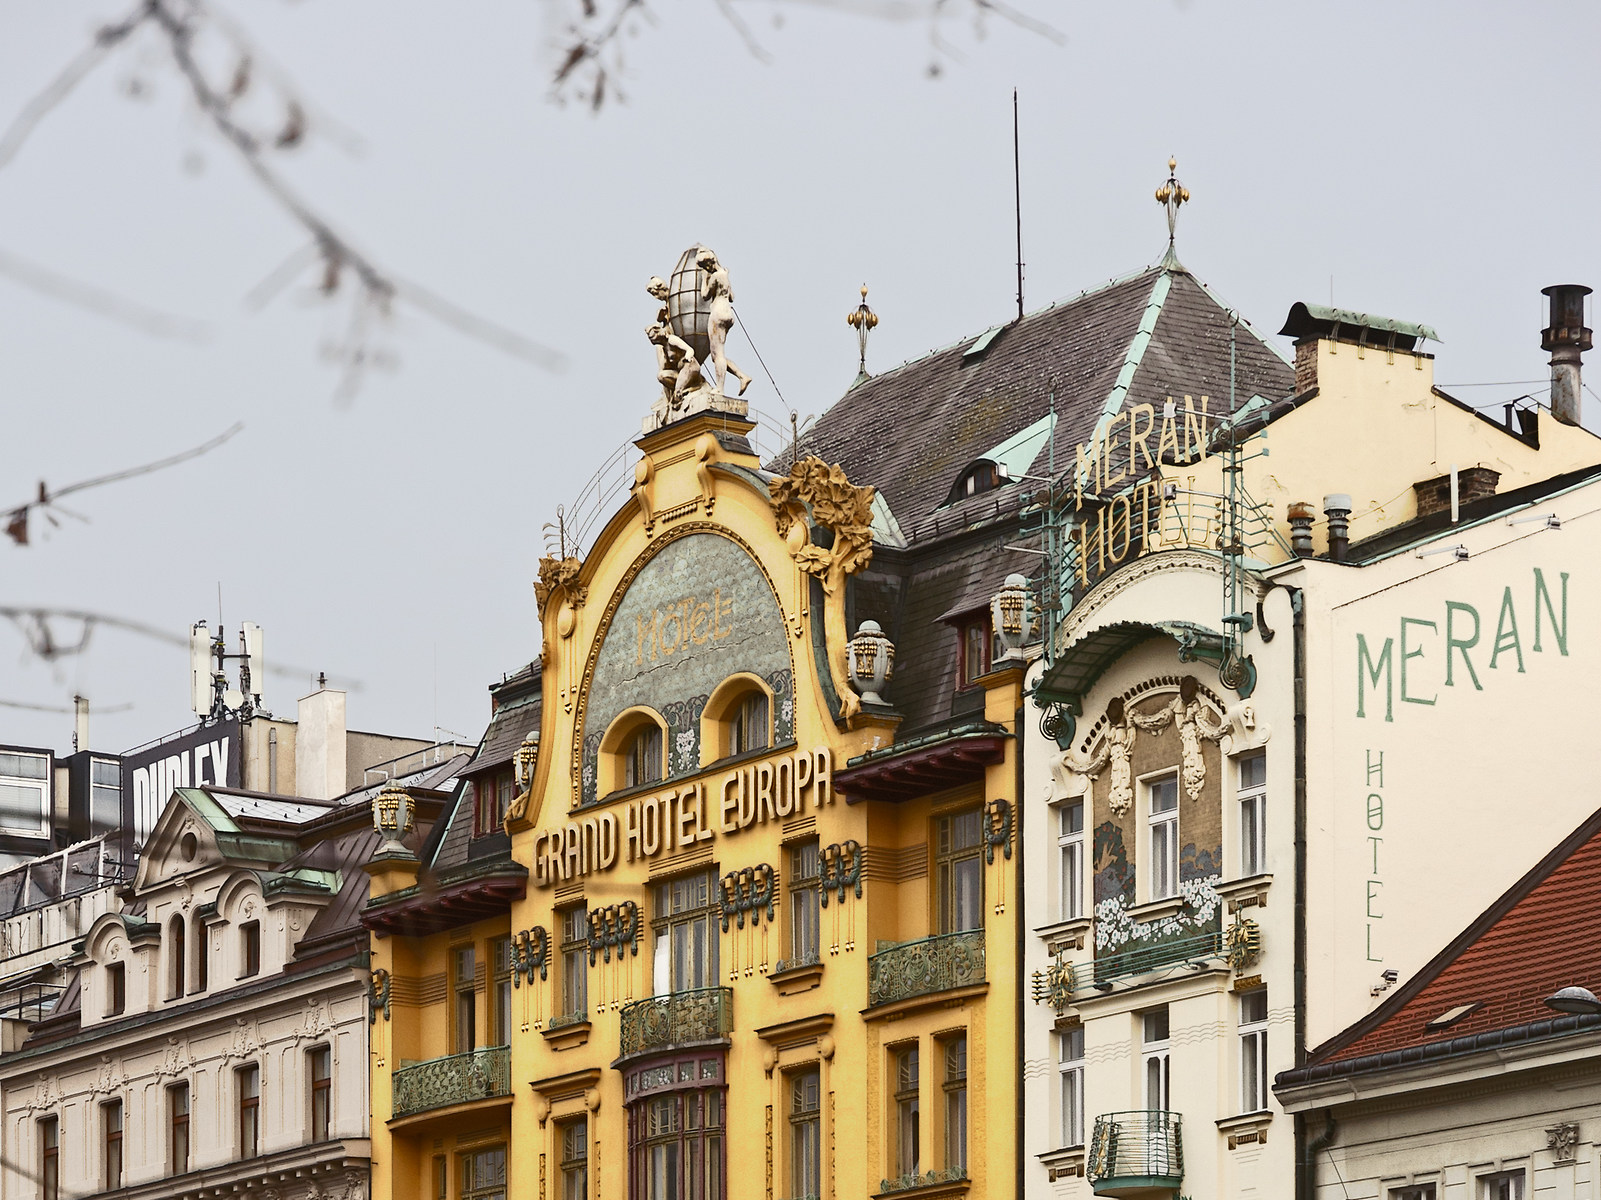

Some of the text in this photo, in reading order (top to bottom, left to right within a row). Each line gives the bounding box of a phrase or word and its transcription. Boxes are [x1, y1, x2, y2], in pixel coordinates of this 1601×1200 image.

[1076, 395, 1209, 512] MERAN
[1080, 476, 1212, 590] HOTEL
[1356, 567, 1570, 722] MERAN
[533, 746, 832, 887] GRAND HOTEL EUROPA
[1366, 749, 1384, 962] HOTEL
